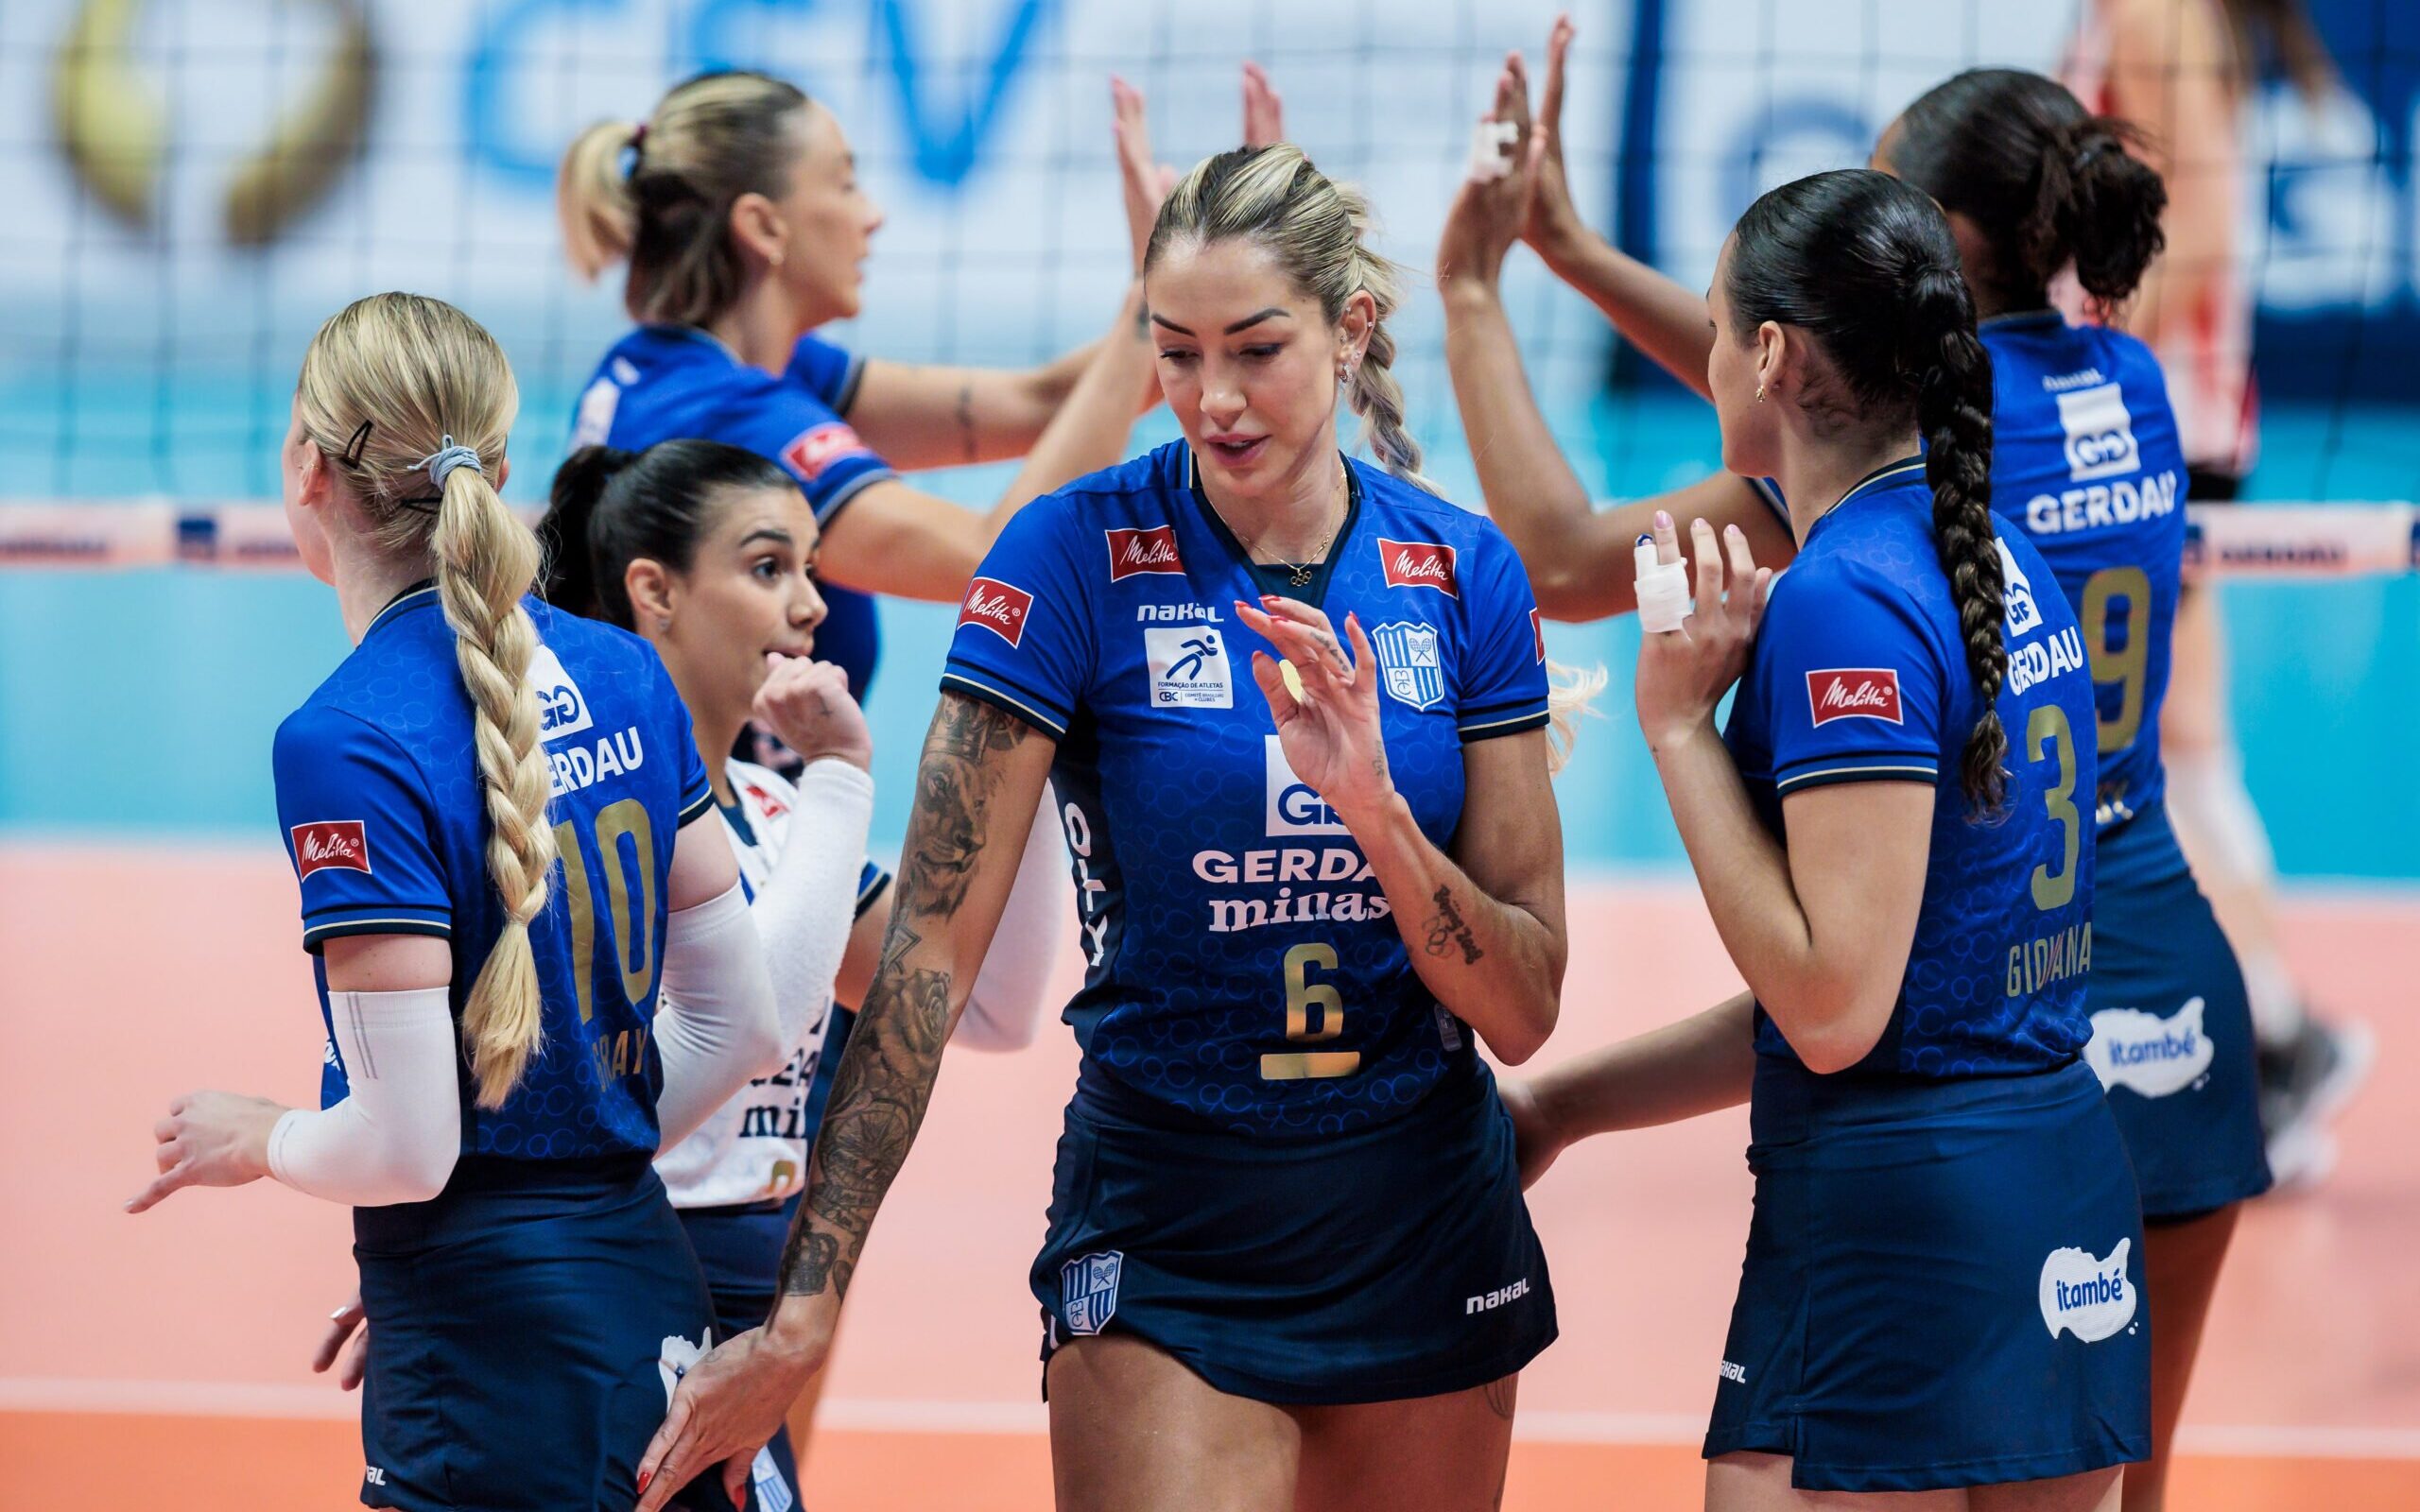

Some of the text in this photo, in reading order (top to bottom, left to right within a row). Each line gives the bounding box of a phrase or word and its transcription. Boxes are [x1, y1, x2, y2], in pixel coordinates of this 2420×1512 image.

[2026, 470, 2177, 535] GERDAU
[1119, 535, 1178, 566] Melitta
[1392, 549, 1448, 580] Melitta
[963, 584, 1012, 625] Melitta
[2083, 565, 2152, 753] 9
[1159, 691, 1179, 702] CBC
[1820, 676, 1889, 711] Melitta
[547, 726, 644, 799] ERDAU
[2026, 704, 2080, 911] 3
[302, 830, 355, 865] Melitta
[1192, 848, 1377, 884] GERD
[552, 799, 657, 1026] 10
[1208, 886, 1392, 932] minas
[1284, 942, 1344, 1041] 6
[1466, 1278, 1530, 1314] nakal
[2056, 1267, 2123, 1312] itambé
